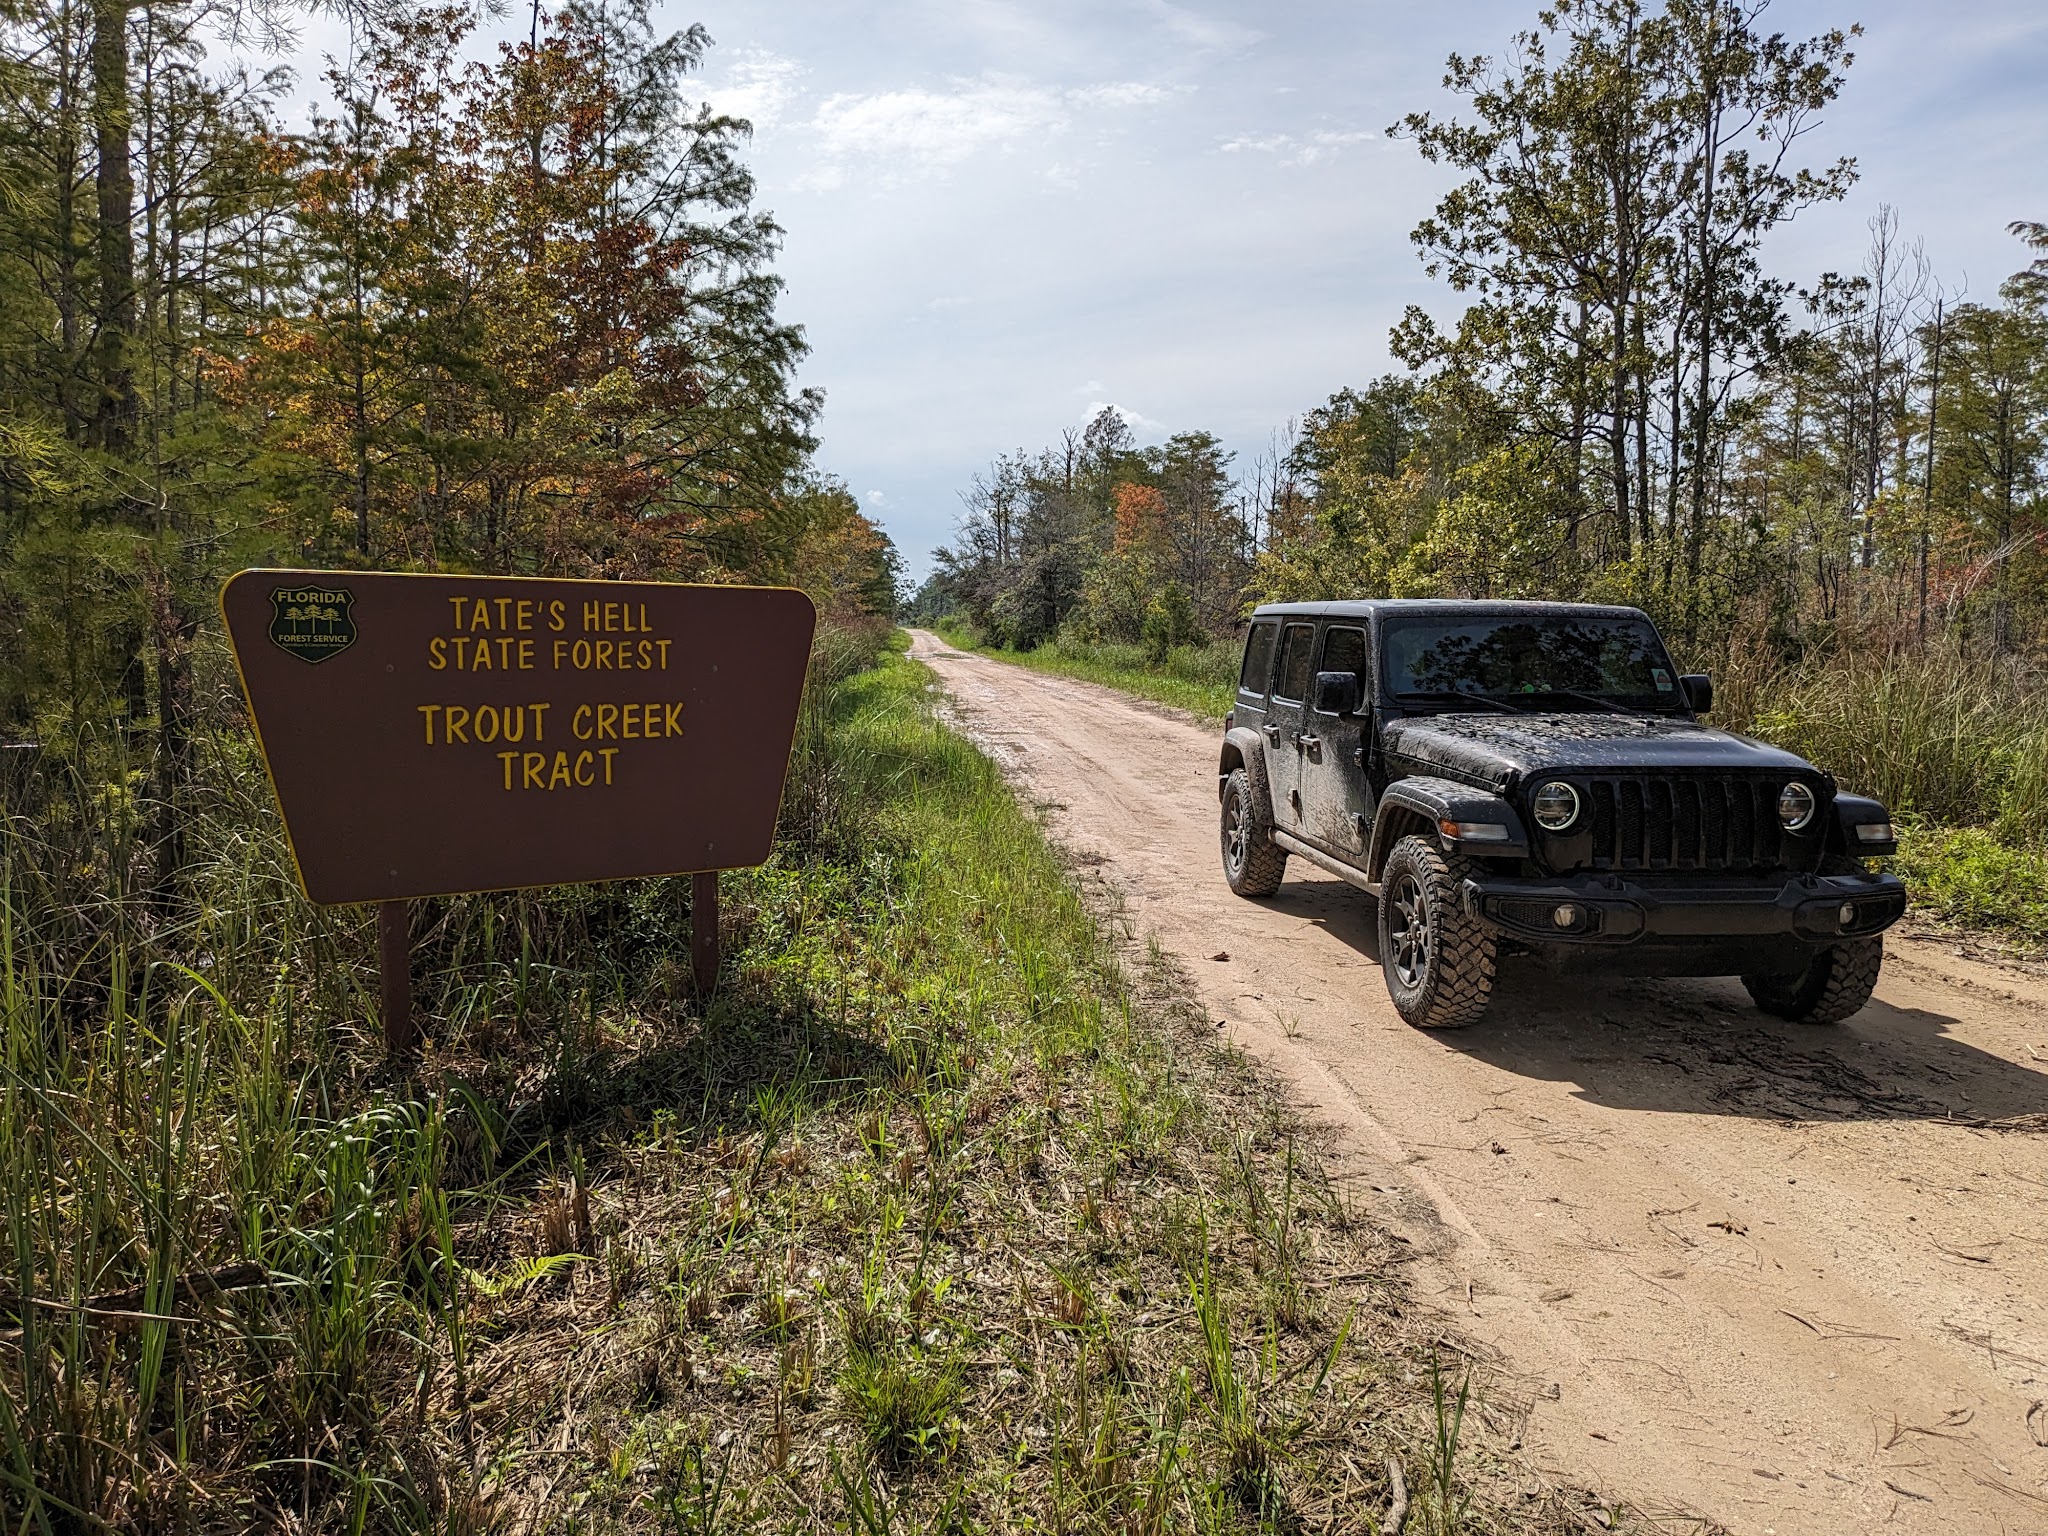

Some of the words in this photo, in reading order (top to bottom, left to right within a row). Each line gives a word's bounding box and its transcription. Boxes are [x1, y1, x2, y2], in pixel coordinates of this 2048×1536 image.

[277, 591, 346, 603] FLORIDA
[449, 597, 566, 633] TATE'S
[583, 600, 653, 633] HELL
[278, 634, 311, 642] FOREST
[428, 637, 534, 672] STATE
[553, 639, 672, 671] FOREST
[417, 703, 550, 745] TROUT
[572, 702, 684, 740] CREEK
[497, 748, 619, 790] TRACT
